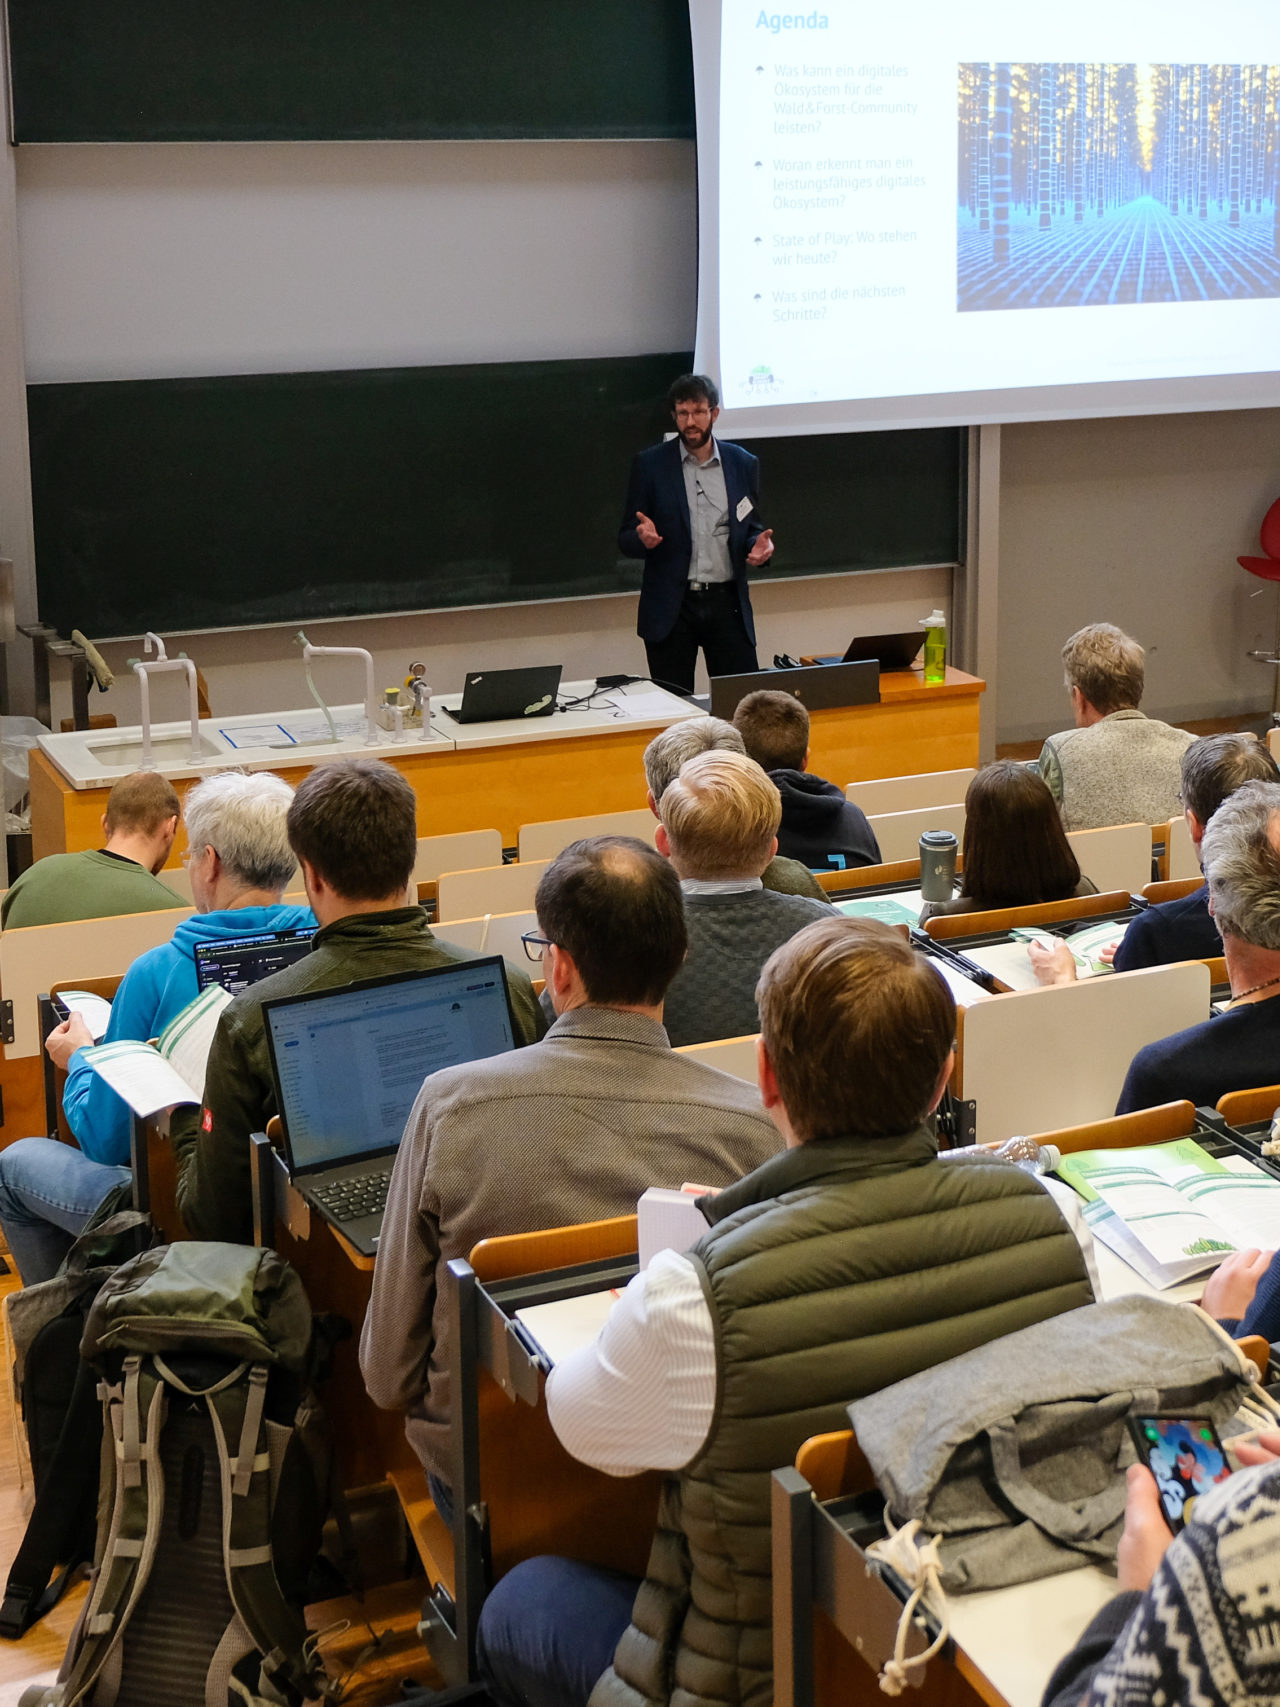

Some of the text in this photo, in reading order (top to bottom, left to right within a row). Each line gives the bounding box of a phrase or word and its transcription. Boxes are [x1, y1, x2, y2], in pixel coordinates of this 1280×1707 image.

[754, 9, 829, 34] Agenda
[774, 64, 909, 80] Was kann ein digitales
[774, 81, 883, 98] Ökosystem für die
[774, 121, 821, 135] leisten?
[773, 157, 913, 172] Woran erkennt man ein
[773, 174, 927, 192] leistungsfähiges digitales
[773, 194, 846, 211] Ökosystem?
[773, 233, 805, 248] State
[808, 232, 822, 246] of
[856, 231, 875, 243] Wo
[878, 230, 918, 243] stehen
[773, 251, 838, 265] wir heute?
[772, 284, 906, 303] Was sind die nächsten
[772, 306, 828, 322] Schritte?
